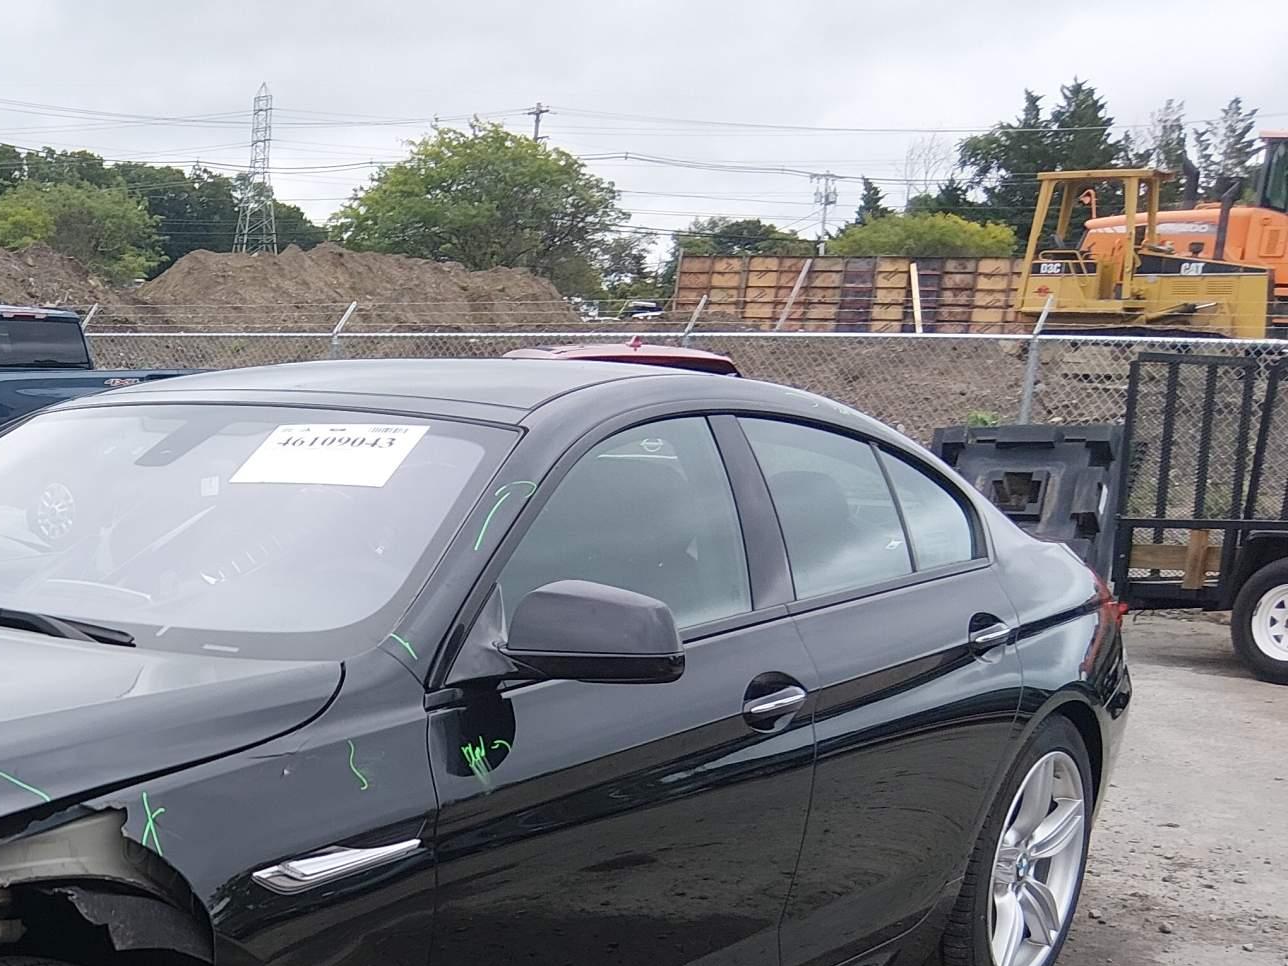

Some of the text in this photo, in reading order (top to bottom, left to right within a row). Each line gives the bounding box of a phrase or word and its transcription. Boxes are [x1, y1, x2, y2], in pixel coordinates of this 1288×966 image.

[1040, 263, 1061, 274] D3C
[1180, 262, 1206, 275] CAT
[277, 436, 397, 449] 46109043
